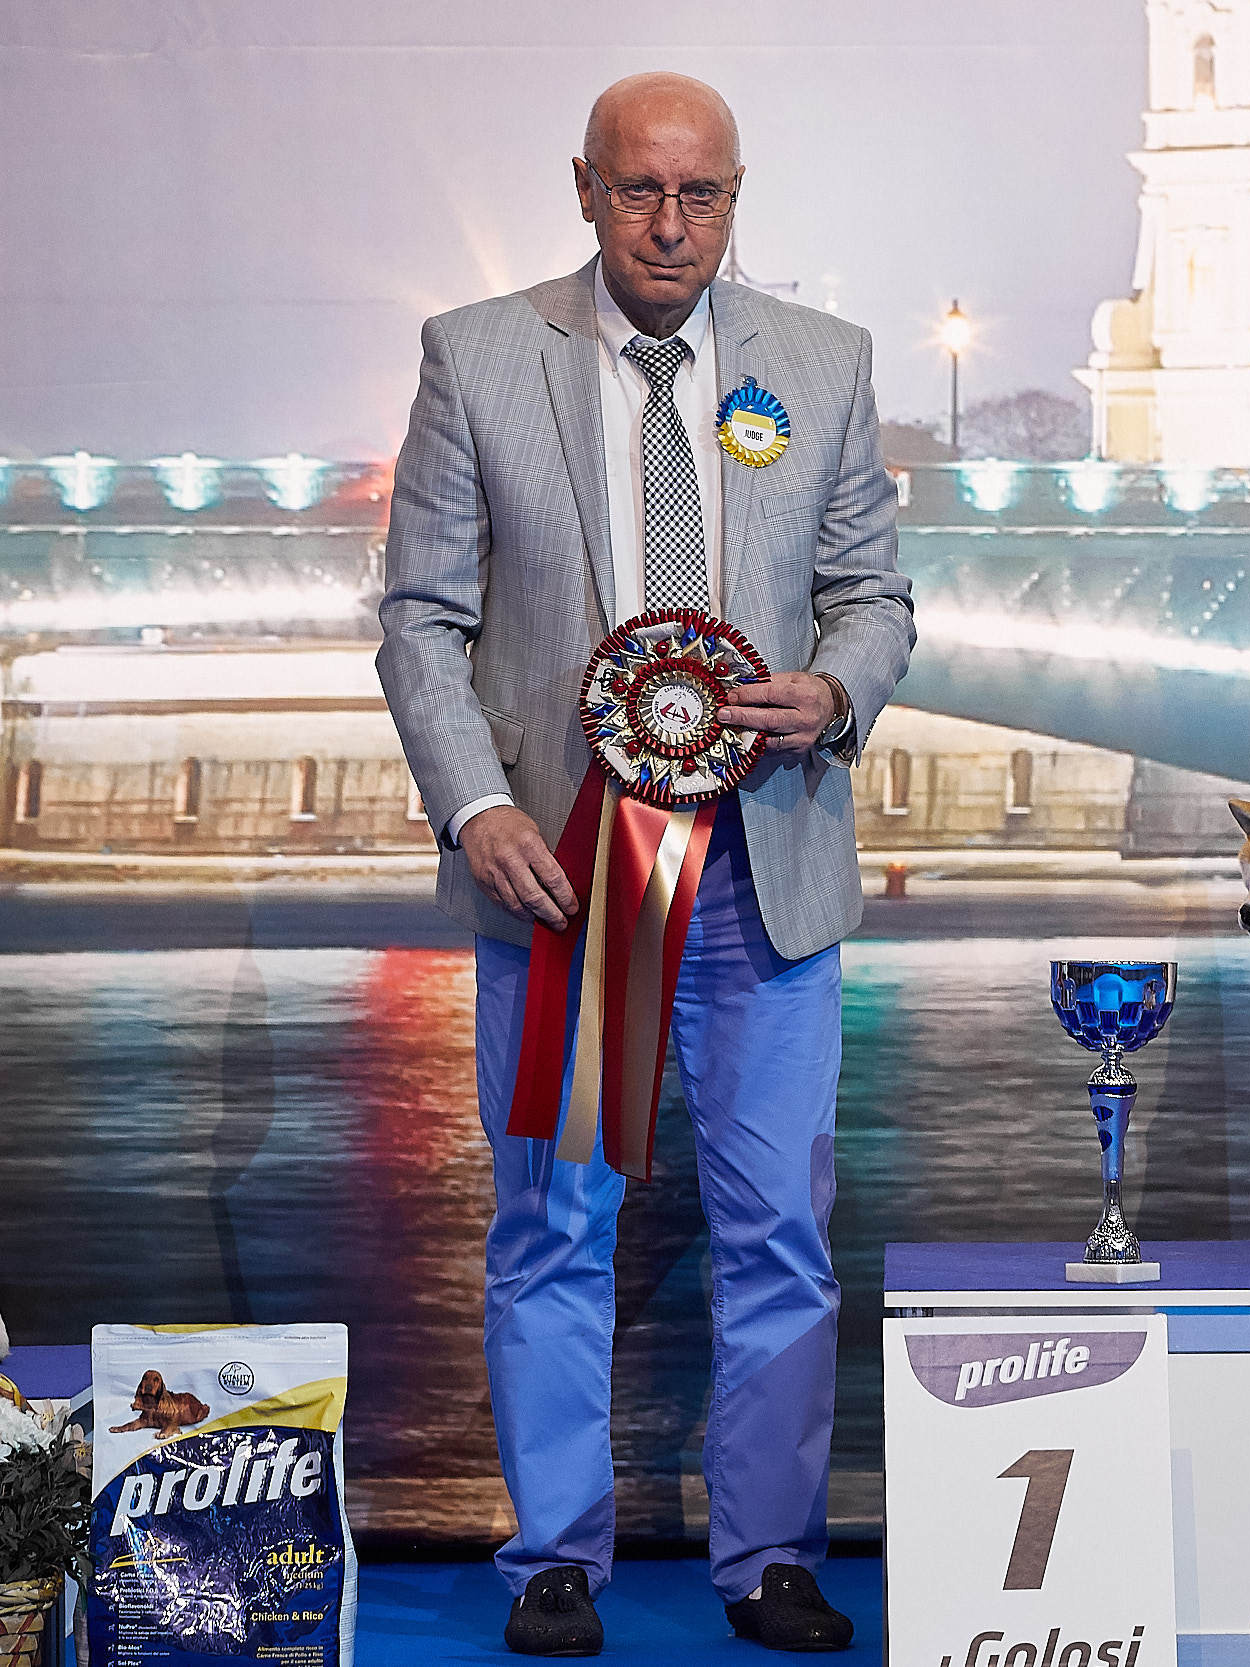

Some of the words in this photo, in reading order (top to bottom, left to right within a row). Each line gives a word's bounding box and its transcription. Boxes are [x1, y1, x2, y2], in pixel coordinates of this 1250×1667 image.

[744, 429, 764, 441] JUDGE
[955, 1337, 1090, 1401] prolife
[110, 1437, 322, 1537] prolife
[996, 1449, 1075, 1590] 1
[267, 1544, 324, 1565] adult
[251, 1611, 289, 1621] Chicken
[291, 1611, 300, 1621] &
